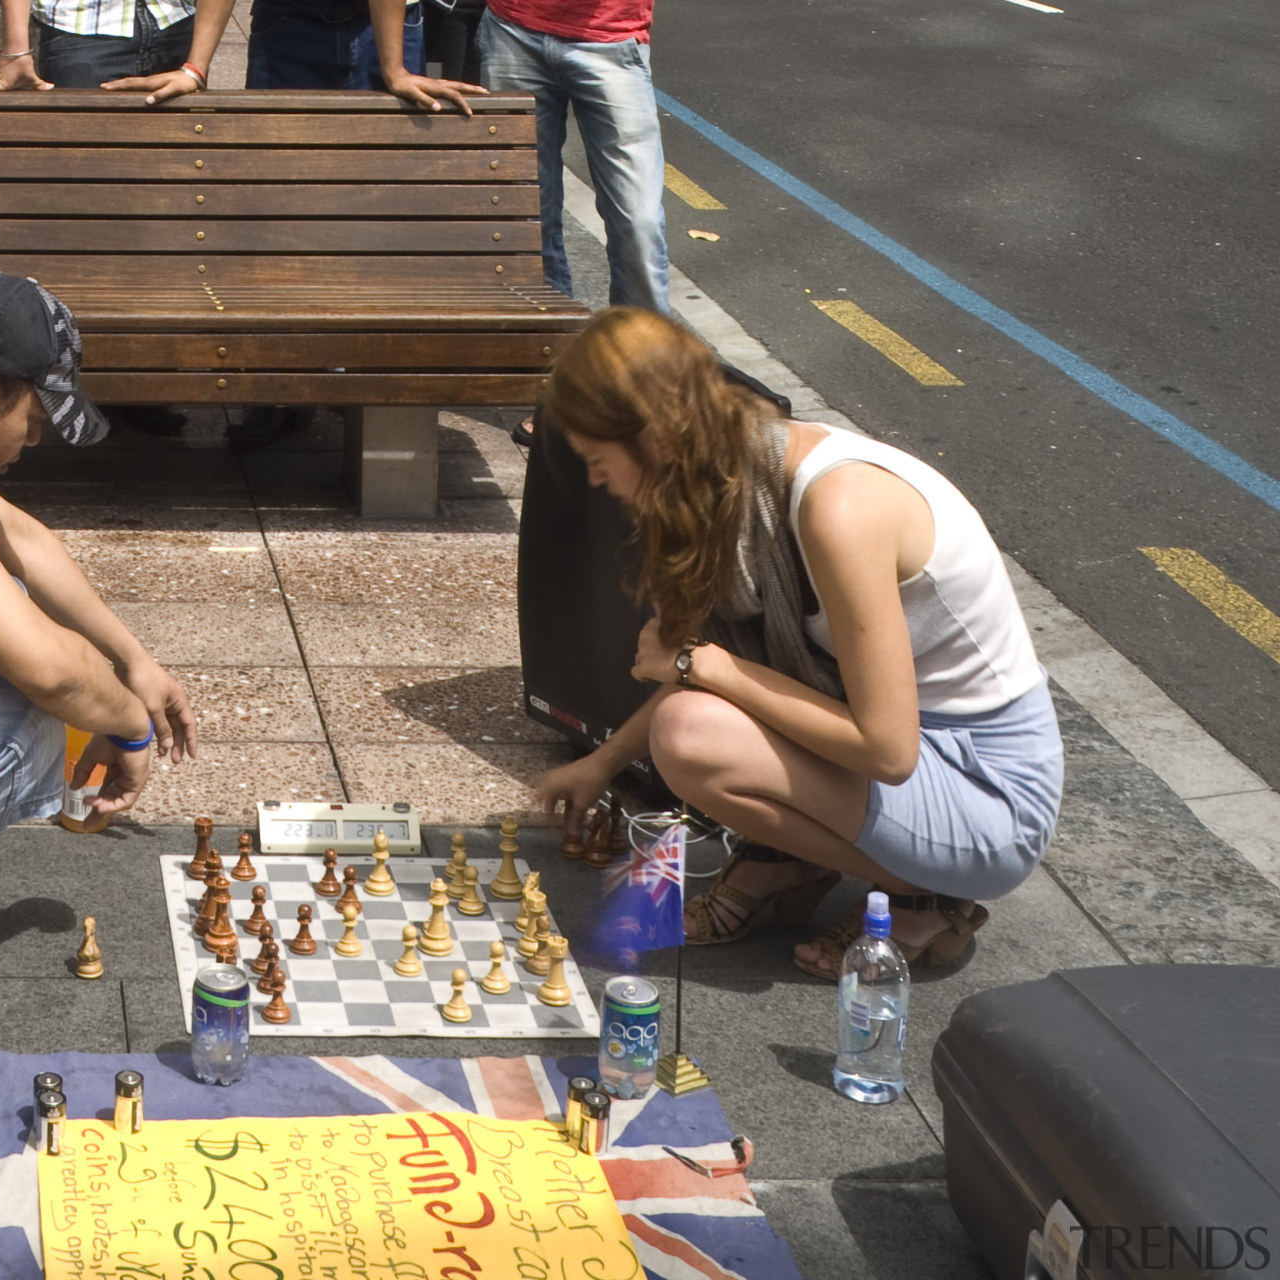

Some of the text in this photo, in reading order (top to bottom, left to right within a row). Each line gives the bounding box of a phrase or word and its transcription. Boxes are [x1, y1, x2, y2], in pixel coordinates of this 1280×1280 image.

[609, 1021, 658, 1047] aqa
[322, 1127, 341, 1149] to
[348, 1119, 378, 1146] to
[162, 1159, 197, 1204] before
[269, 1157, 290, 1181] in
[467, 1119, 558, 1243] Breast
[287, 1126, 309, 1151] to
[309, 1229, 343, 1256] ill
[349, 1151, 412, 1251] purchase
